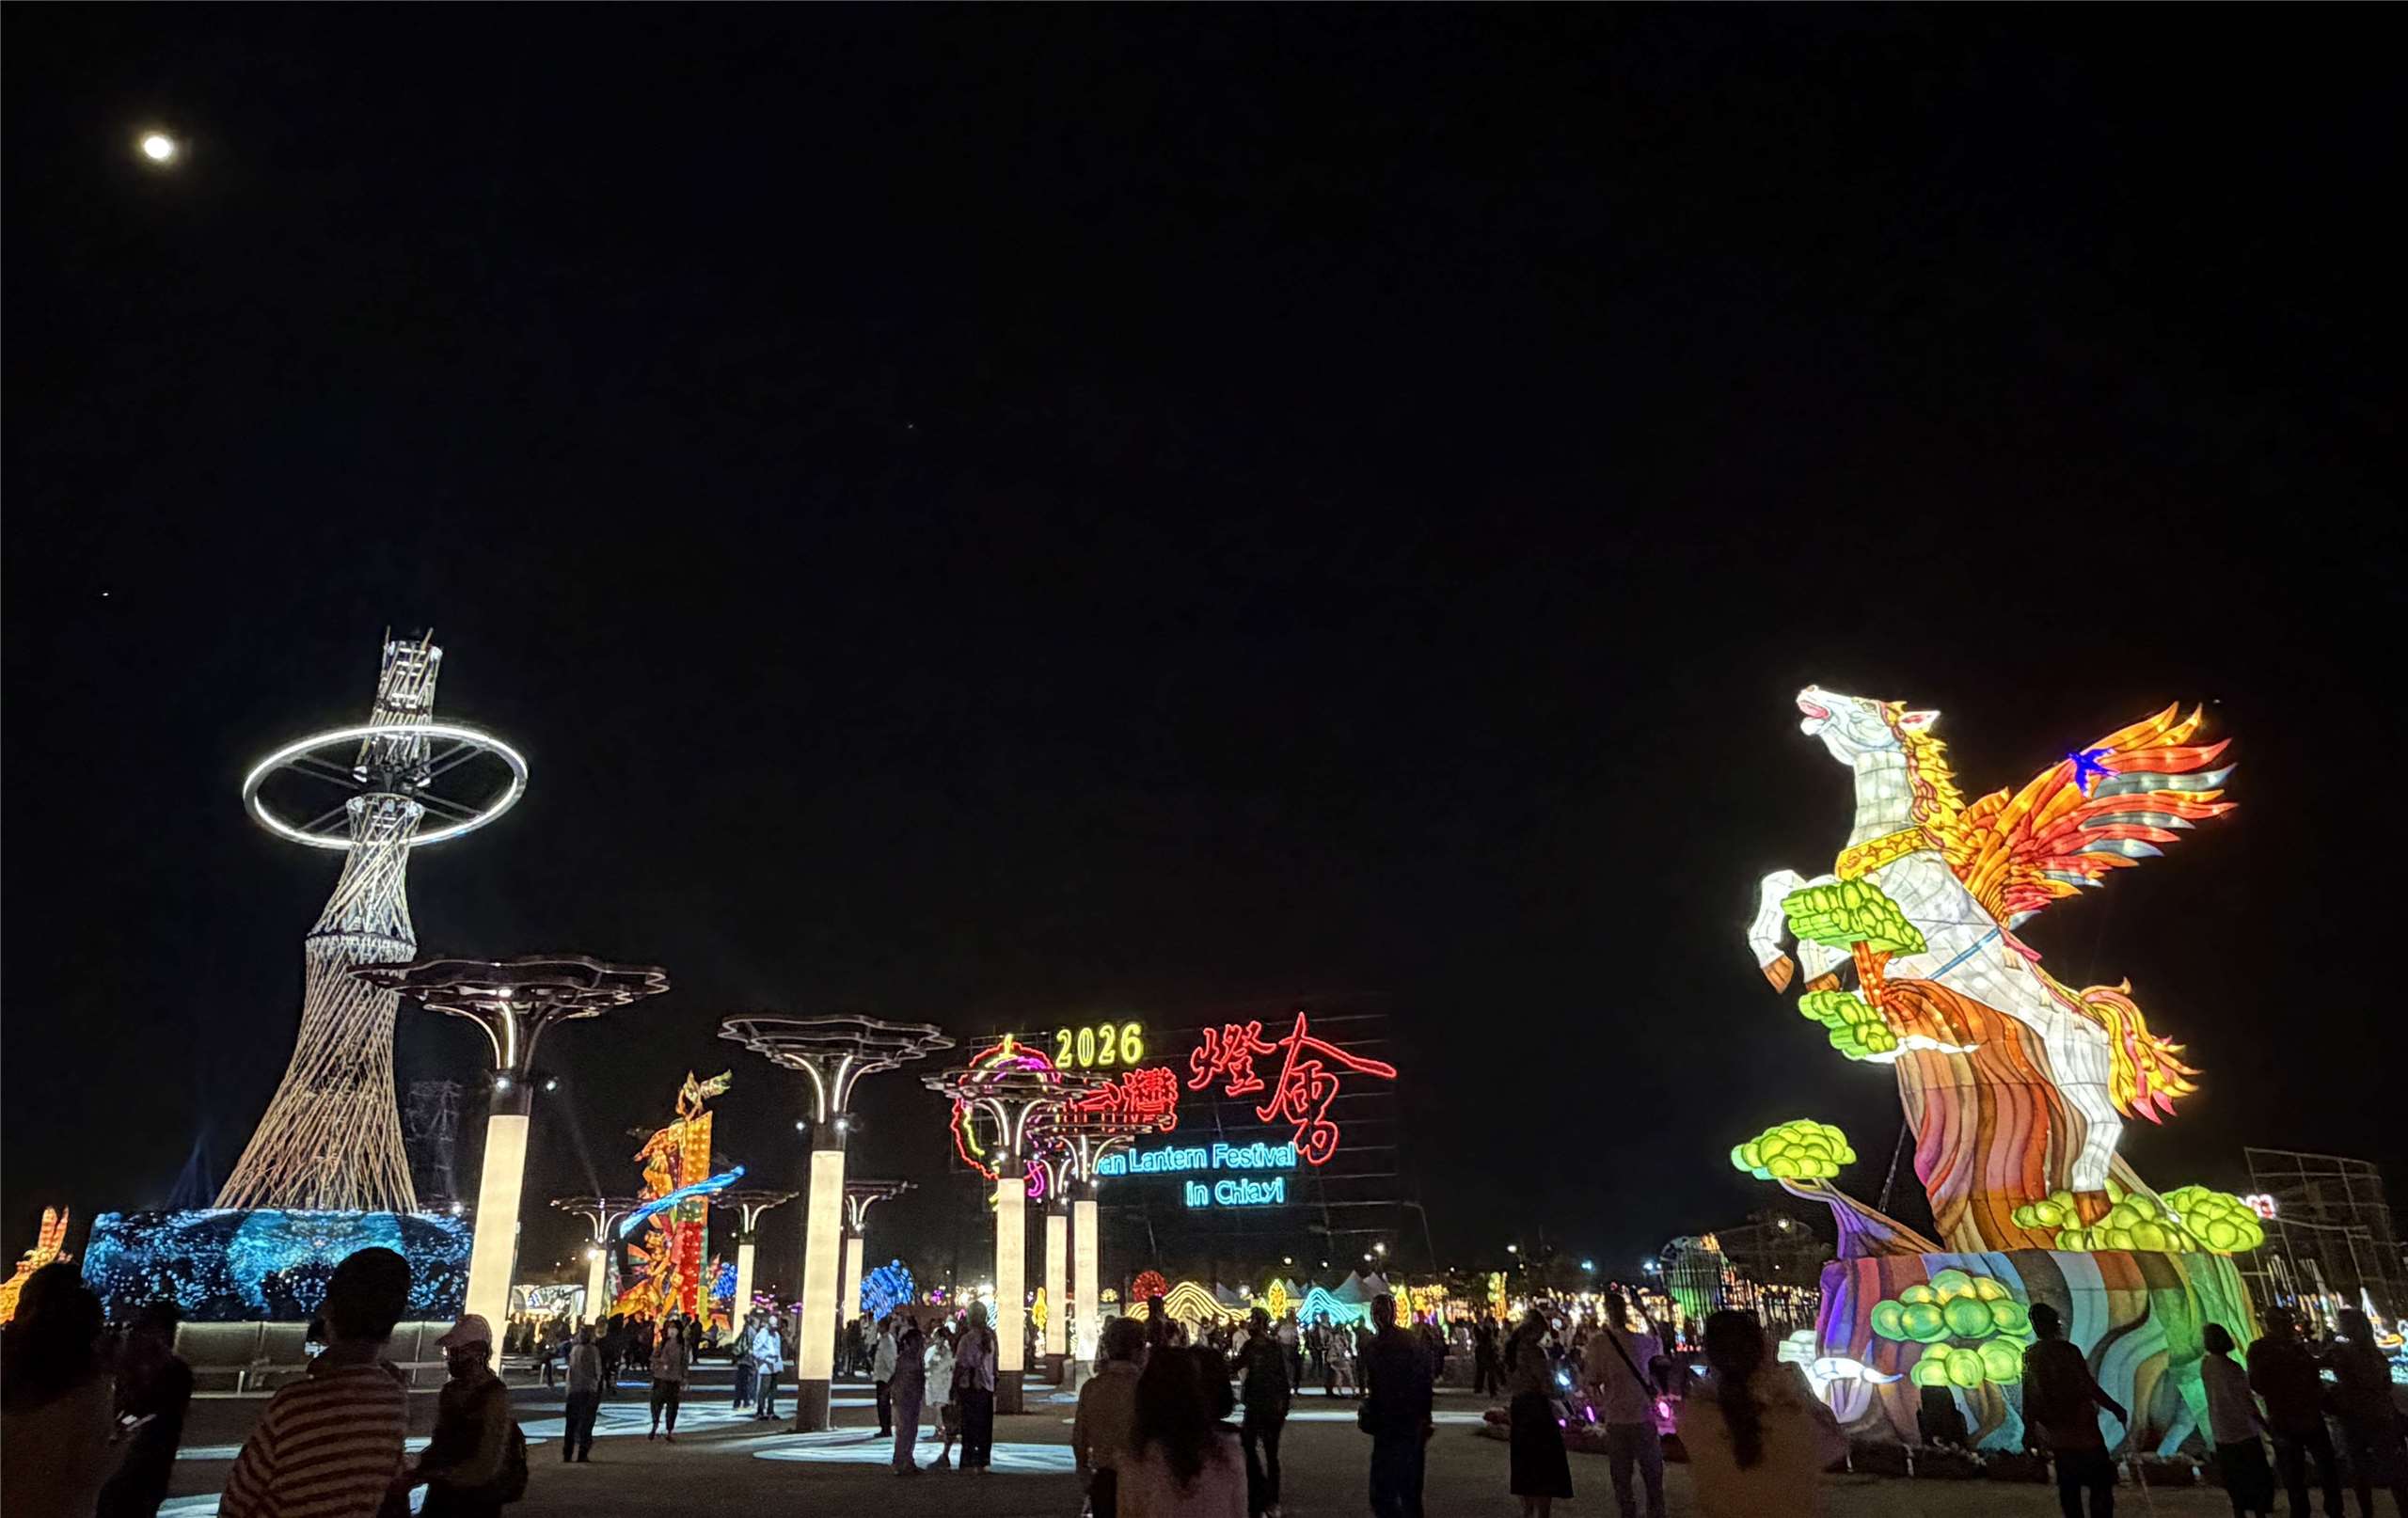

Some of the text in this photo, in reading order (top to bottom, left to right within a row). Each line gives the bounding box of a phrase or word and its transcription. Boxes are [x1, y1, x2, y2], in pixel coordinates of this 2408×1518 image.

[1055, 1023, 1145, 1068] 2026
[1129, 1146, 1209, 1173] Lantern
[1212, 1142, 1297, 1169] Festival
[1185, 1176, 1285, 1207] in Chiayi
